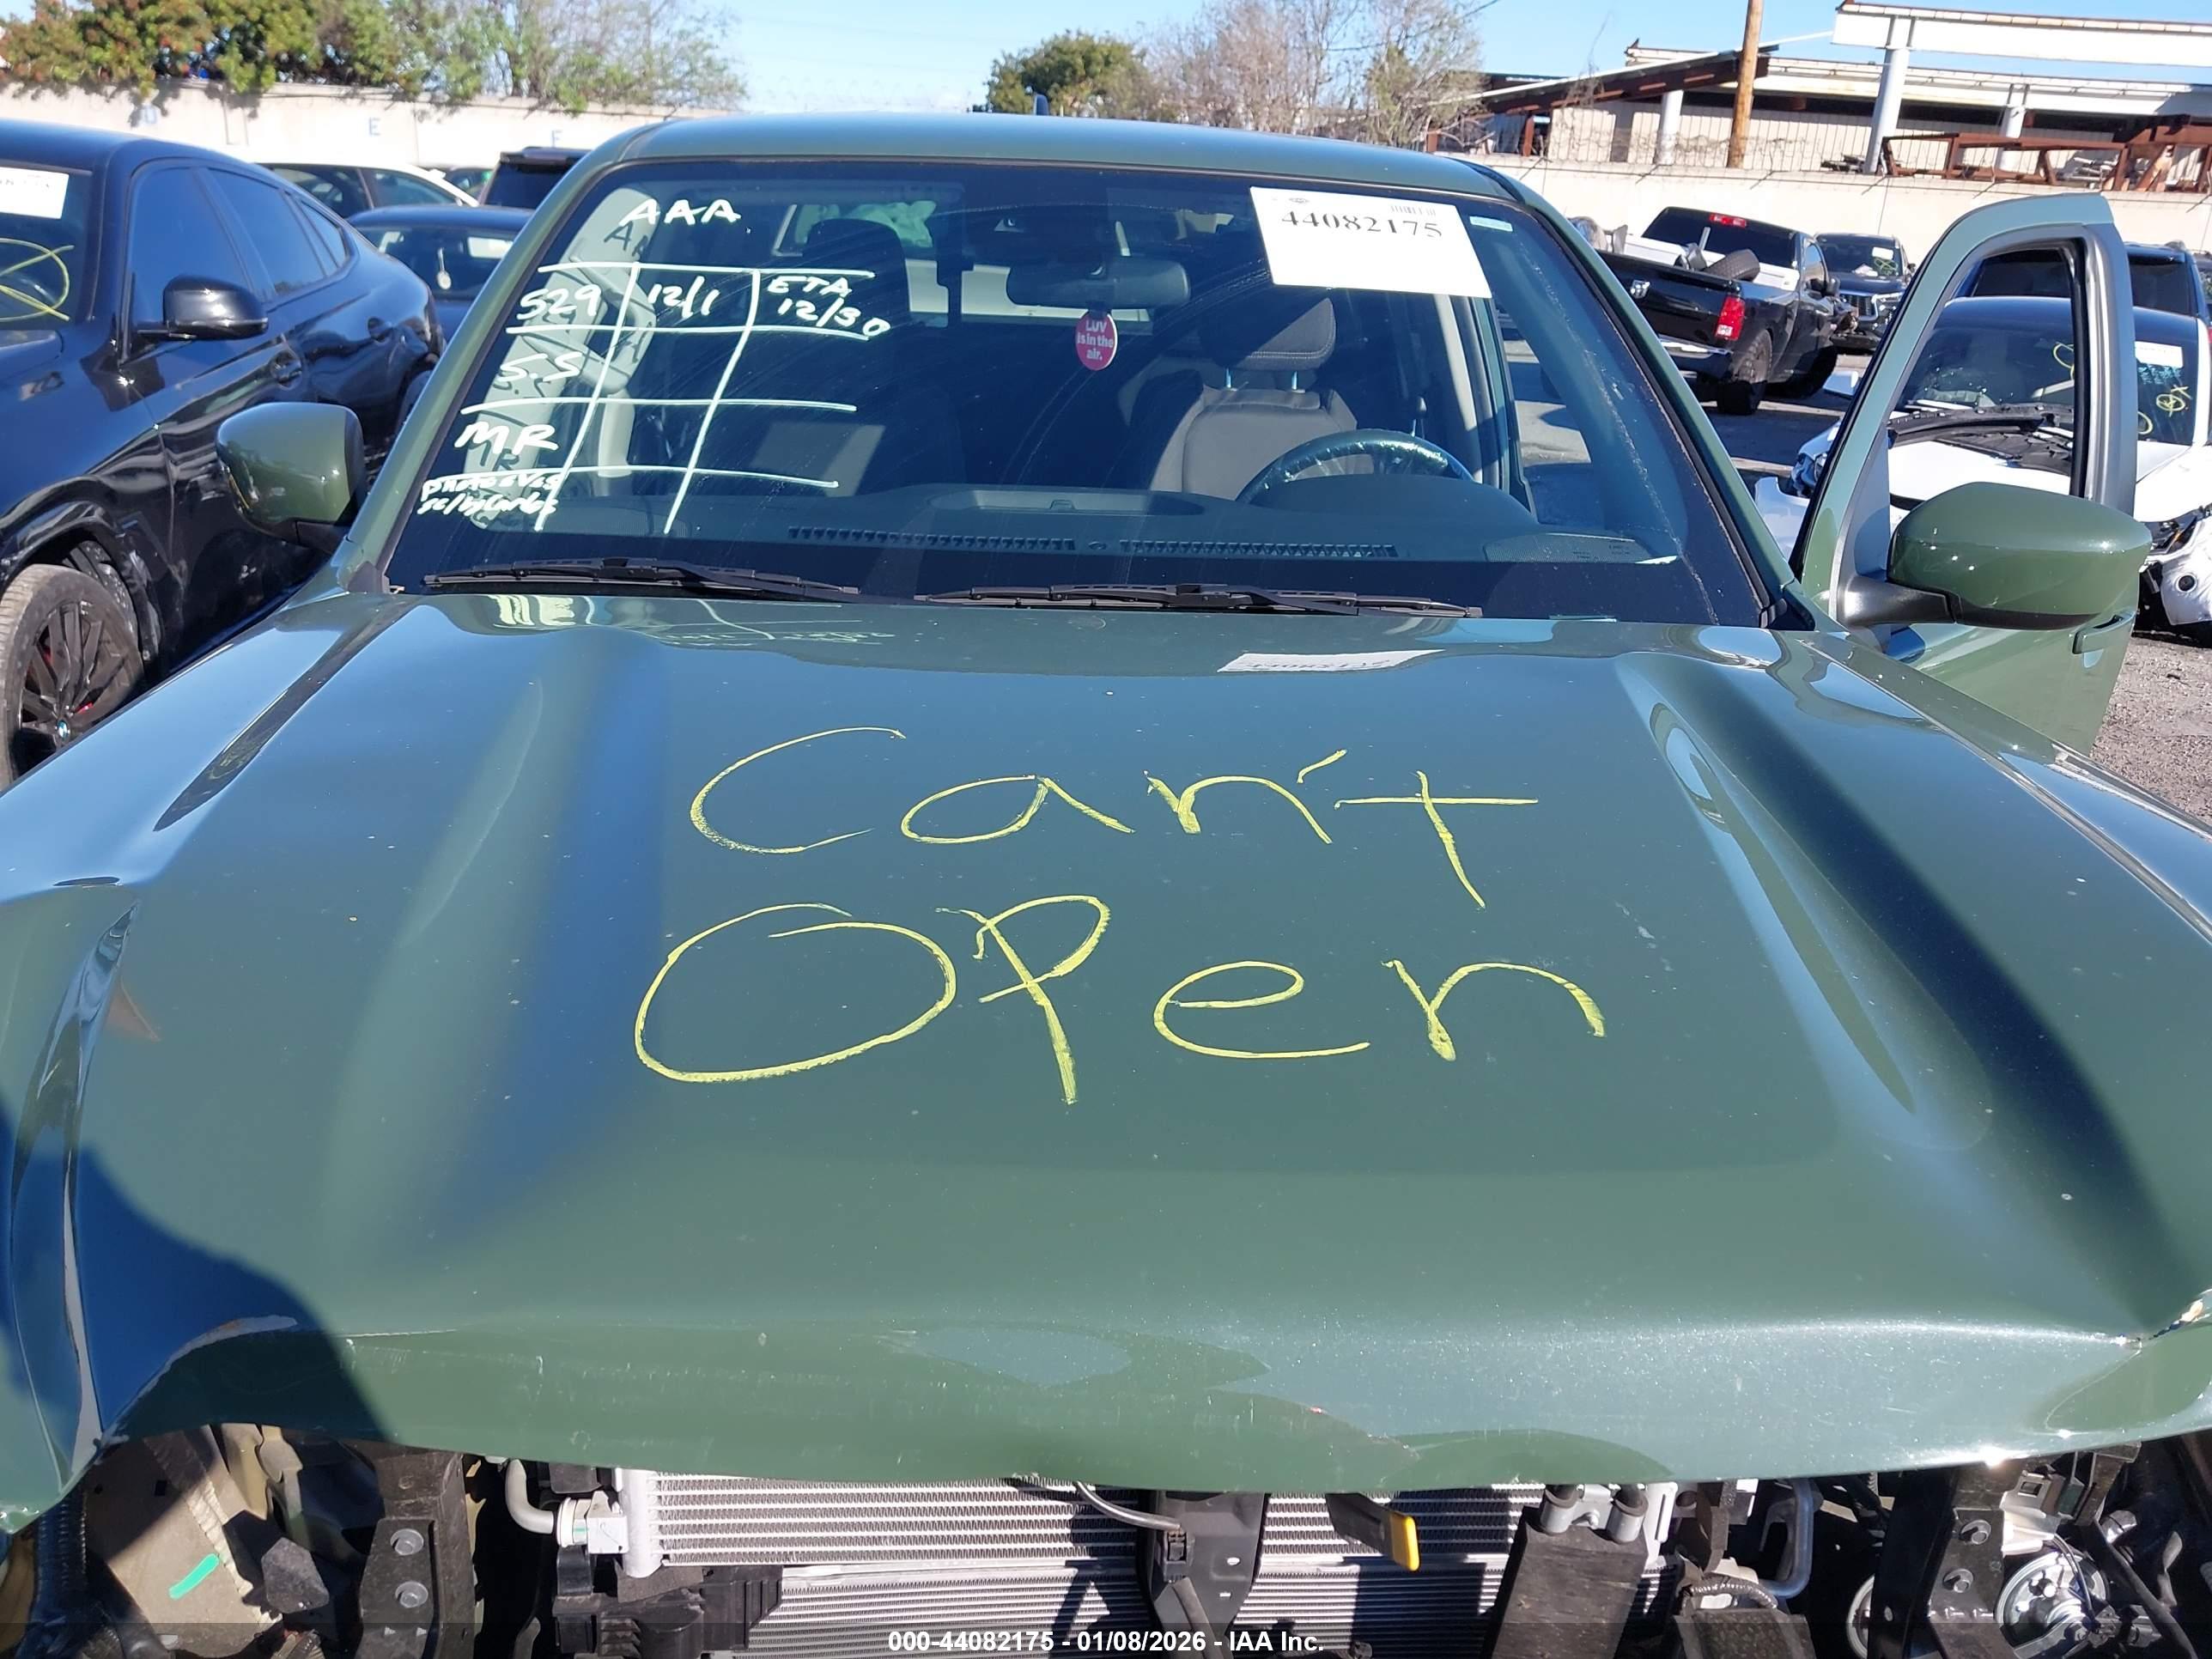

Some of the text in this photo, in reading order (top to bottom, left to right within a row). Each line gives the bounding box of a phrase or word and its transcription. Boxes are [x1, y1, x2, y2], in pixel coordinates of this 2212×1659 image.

[368, 117, 381, 137] E
[618, 198, 741, 227] AAA
[1281, 210, 1443, 238] 44082175
[648, 275, 719, 319] 12/1
[767, 275, 853, 297] ETA
[777, 297, 891, 338] 12/30
[1097, 335, 1114, 349] the
[453, 422, 560, 455] MR
[690, 726, 1539, 909] Can't
